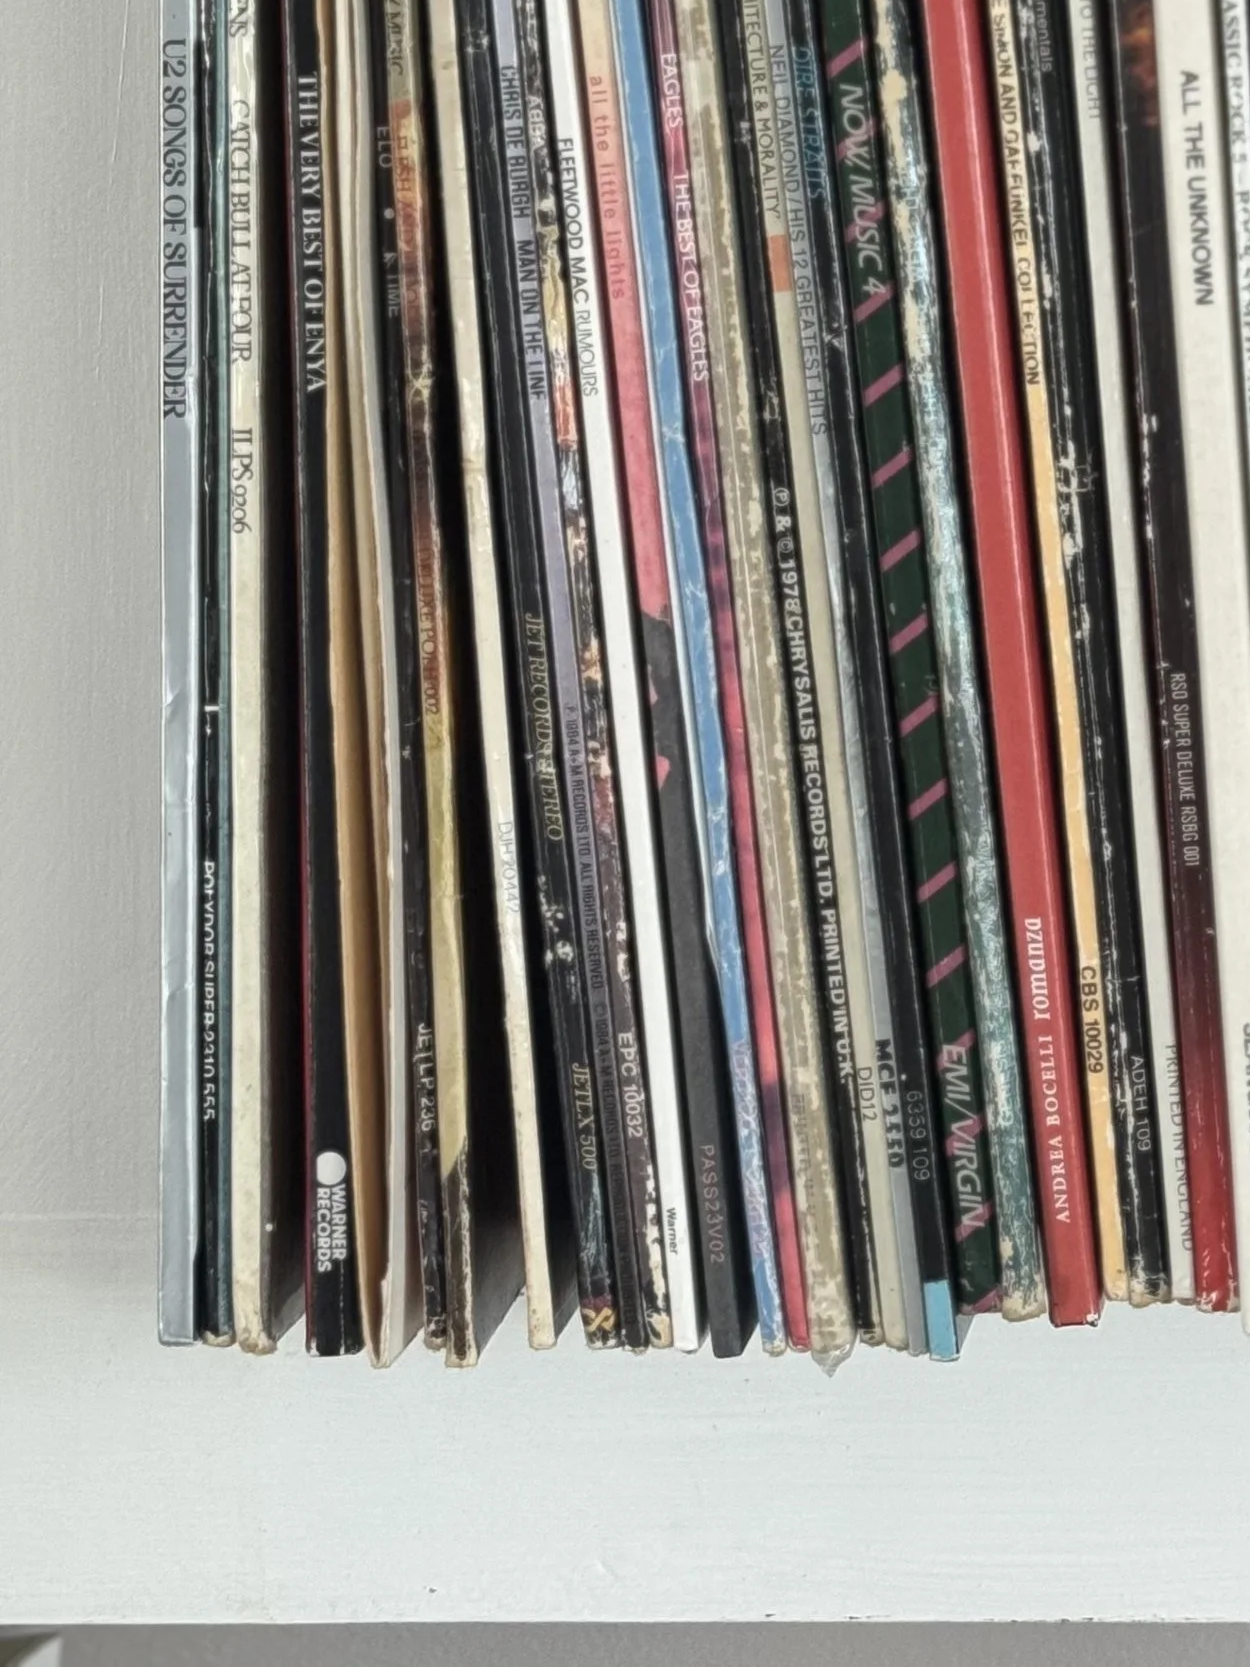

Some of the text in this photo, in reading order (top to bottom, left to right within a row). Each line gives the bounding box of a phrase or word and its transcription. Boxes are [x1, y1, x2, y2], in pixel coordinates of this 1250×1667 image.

[228, 99, 250, 184] CATCH
[752, 99, 770, 111] &
[792, 46, 824, 200] DIRE STRAITS
[998, 83, 1019, 124] AND
[162, 38, 186, 418] U2 SONGS OF SURRENDER
[229, 190, 252, 260] BULL
[296, 72, 326, 393] THE VERY BEST OF ENYA
[376, 126, 402, 318] ELO TIME
[499, 65, 541, 355] CHRIS DE BURGH MAN ON THE
[588, 76, 626, 299] all the little lights
[659, 53, 709, 381] EAGLES THE BEST OF EAGLES
[767, 44, 827, 436] NEIL DIAMOND HIS 12 GREATEST HITS
[848, 174, 885, 295] MUSIC 4
[1179, 70, 1214, 306] ALL THE UNKNOWN
[230, 262, 252, 293] AT
[556, 138, 598, 397] FLEETWOOD MAC RUMOURS
[230, 296, 252, 364] FOUR
[230, 428, 253, 482] ILPS
[229, 484, 250, 534] 9206
[778, 559, 801, 611] 1978
[523, 613, 563, 841] JET RECORDS STEREO
[785, 616, 816, 740] CHRYSALIS
[798, 745, 827, 850] RECORDS
[1169, 673, 1200, 866] RSO SUPER DELUXE RSBG 001
[812, 855, 834, 904] LTD.
[819, 909, 846, 1008] PRINTED
[830, 1010, 848, 1032] IN
[1023, 917, 1071, 1223] ANDREA BOCELLI romanza
[1079, 966, 1103, 1073] CBS 10029
[419, 1097, 436, 1131] 236
[616, 1032, 643, 1138] EPC 10032
[855, 1066, 878, 1122] DID12
[904, 1090, 929, 1180] 6359 109
[941, 1043, 985, 1228] EMI/VIRGIN
[1129, 1056, 1152, 1151] ADEH 109
[579, 1134, 598, 1170] 500
[1164, 1044, 1193, 1251] PRINTED IN ENGLAND
[314, 1187, 332, 1272] RECORDS
[330, 1184, 346, 1261] WARNER
[665, 1207, 679, 1255] Warner
[700, 1145, 725, 1264] PASS23V02
